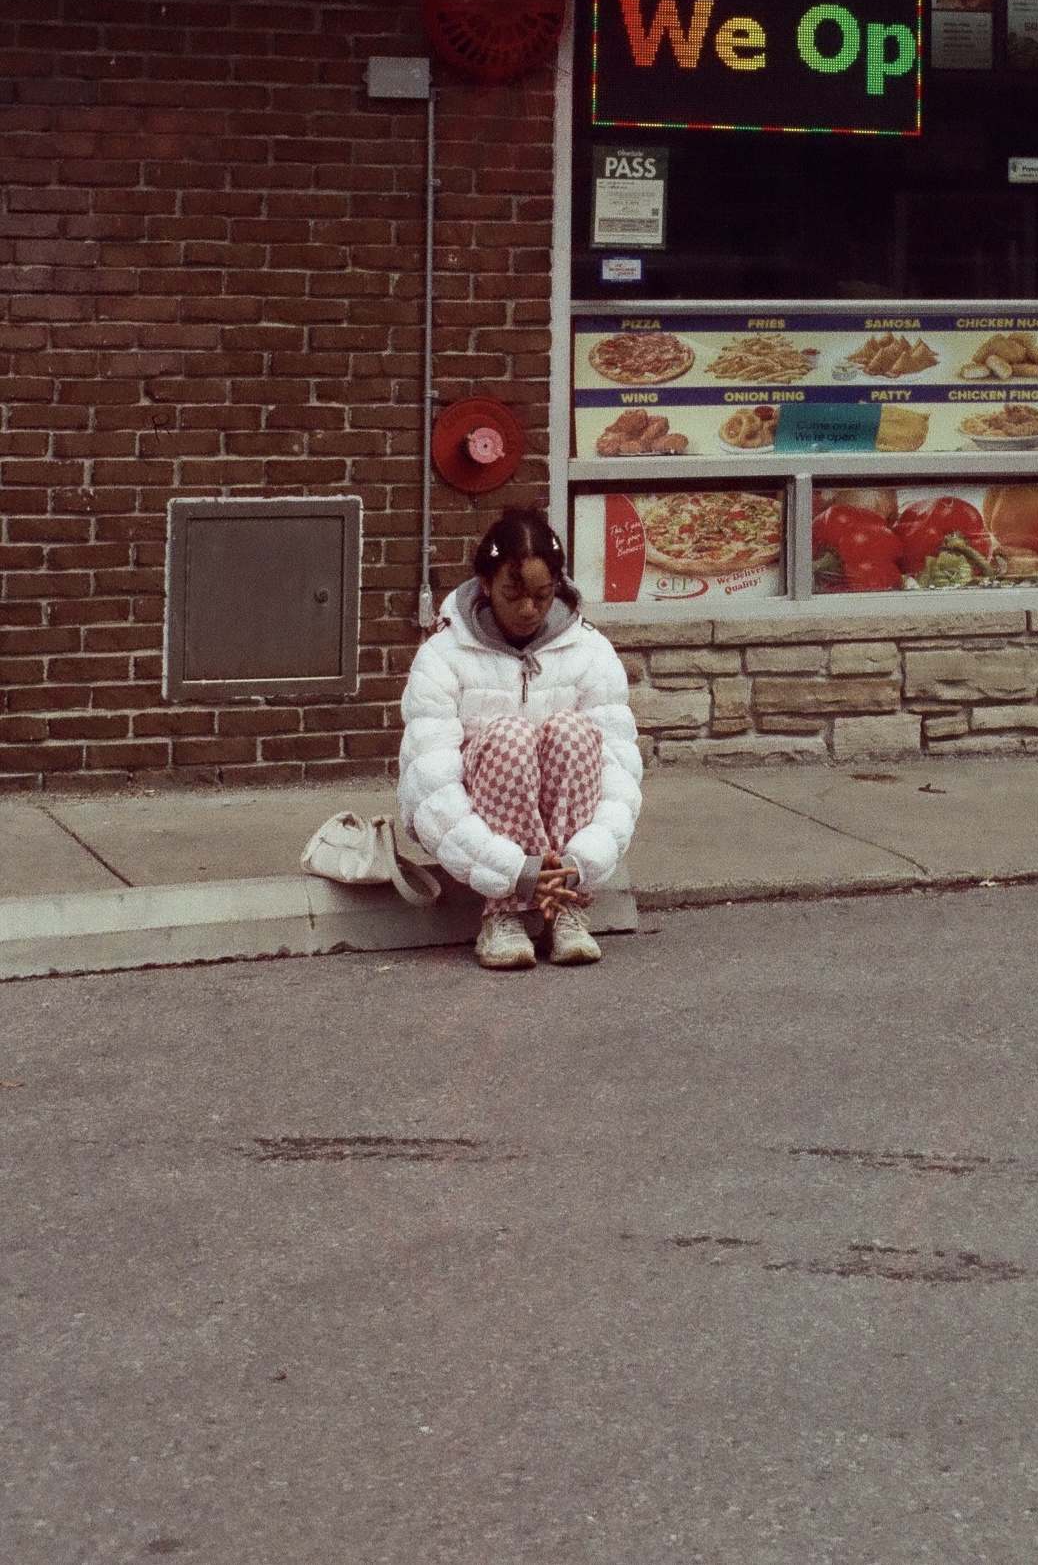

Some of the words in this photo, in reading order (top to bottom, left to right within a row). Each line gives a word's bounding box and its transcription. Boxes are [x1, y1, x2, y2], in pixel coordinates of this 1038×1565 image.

[797, 3, 916, 95] Op
[604, 156, 657, 178] PASS
[621, 319, 661, 330] PIZZA
[748, 319, 786, 329] FRIES
[865, 319, 921, 329] SAMOSA
[956, 318, 1013, 328] CHICKEN
[621, 393, 659, 403] WING
[724, 392, 769, 402] ONION
[772, 392, 805, 402] RING
[871, 391, 912, 401] PATTY
[948, 390, 1006, 400] CHICKEN
[796, 421, 830, 430] Come
[716, 575, 731, 585] We
[732, 565, 767, 581] Deliver
[724, 576, 762, 595] Quality!
